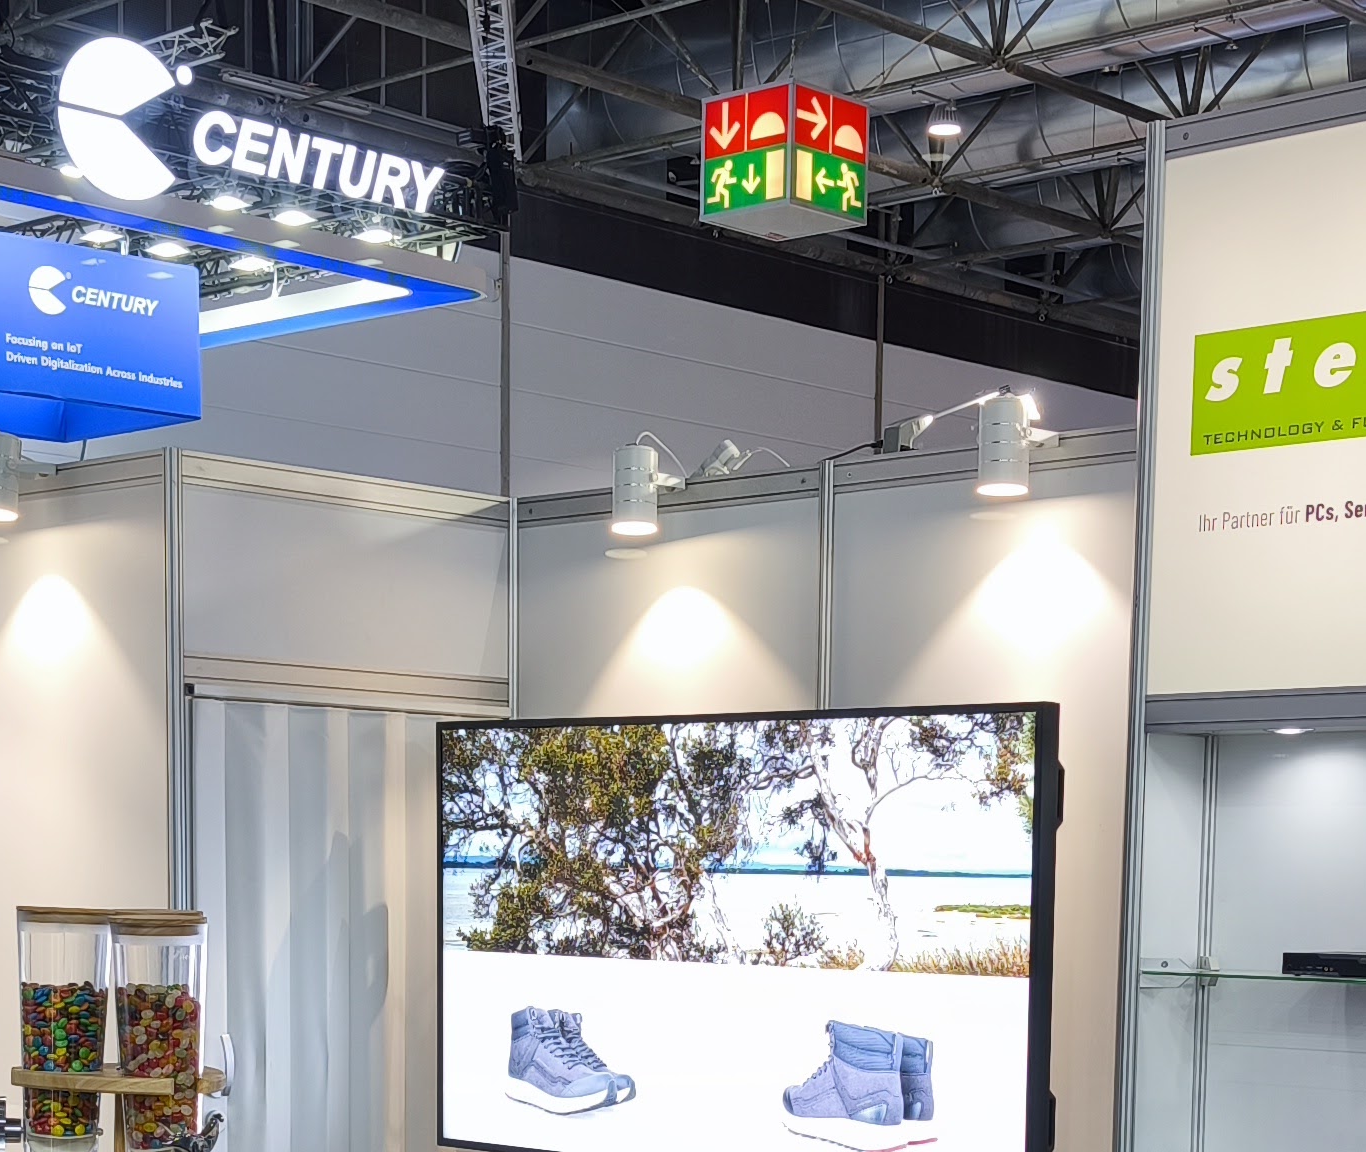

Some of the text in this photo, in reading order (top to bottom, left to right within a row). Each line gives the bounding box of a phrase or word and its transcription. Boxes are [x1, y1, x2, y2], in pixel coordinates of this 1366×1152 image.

[193, 110, 445, 213] CENTURY
[71, 285, 159, 317] CENTURY
[5, 333, 83, 354] Focusing on IoT
[6, 351, 183, 389] Driven Digitalization Across Industries
[1203, 421, 1325, 446] TECHNOLOGY
[1332, 418, 1344, 431] &
[1198, 513, 1218, 532] Ihr
[1222, 509, 1274, 530] Partner
[1279, 505, 1300, 524] für
[1305, 502, 1339, 523] PCs,
